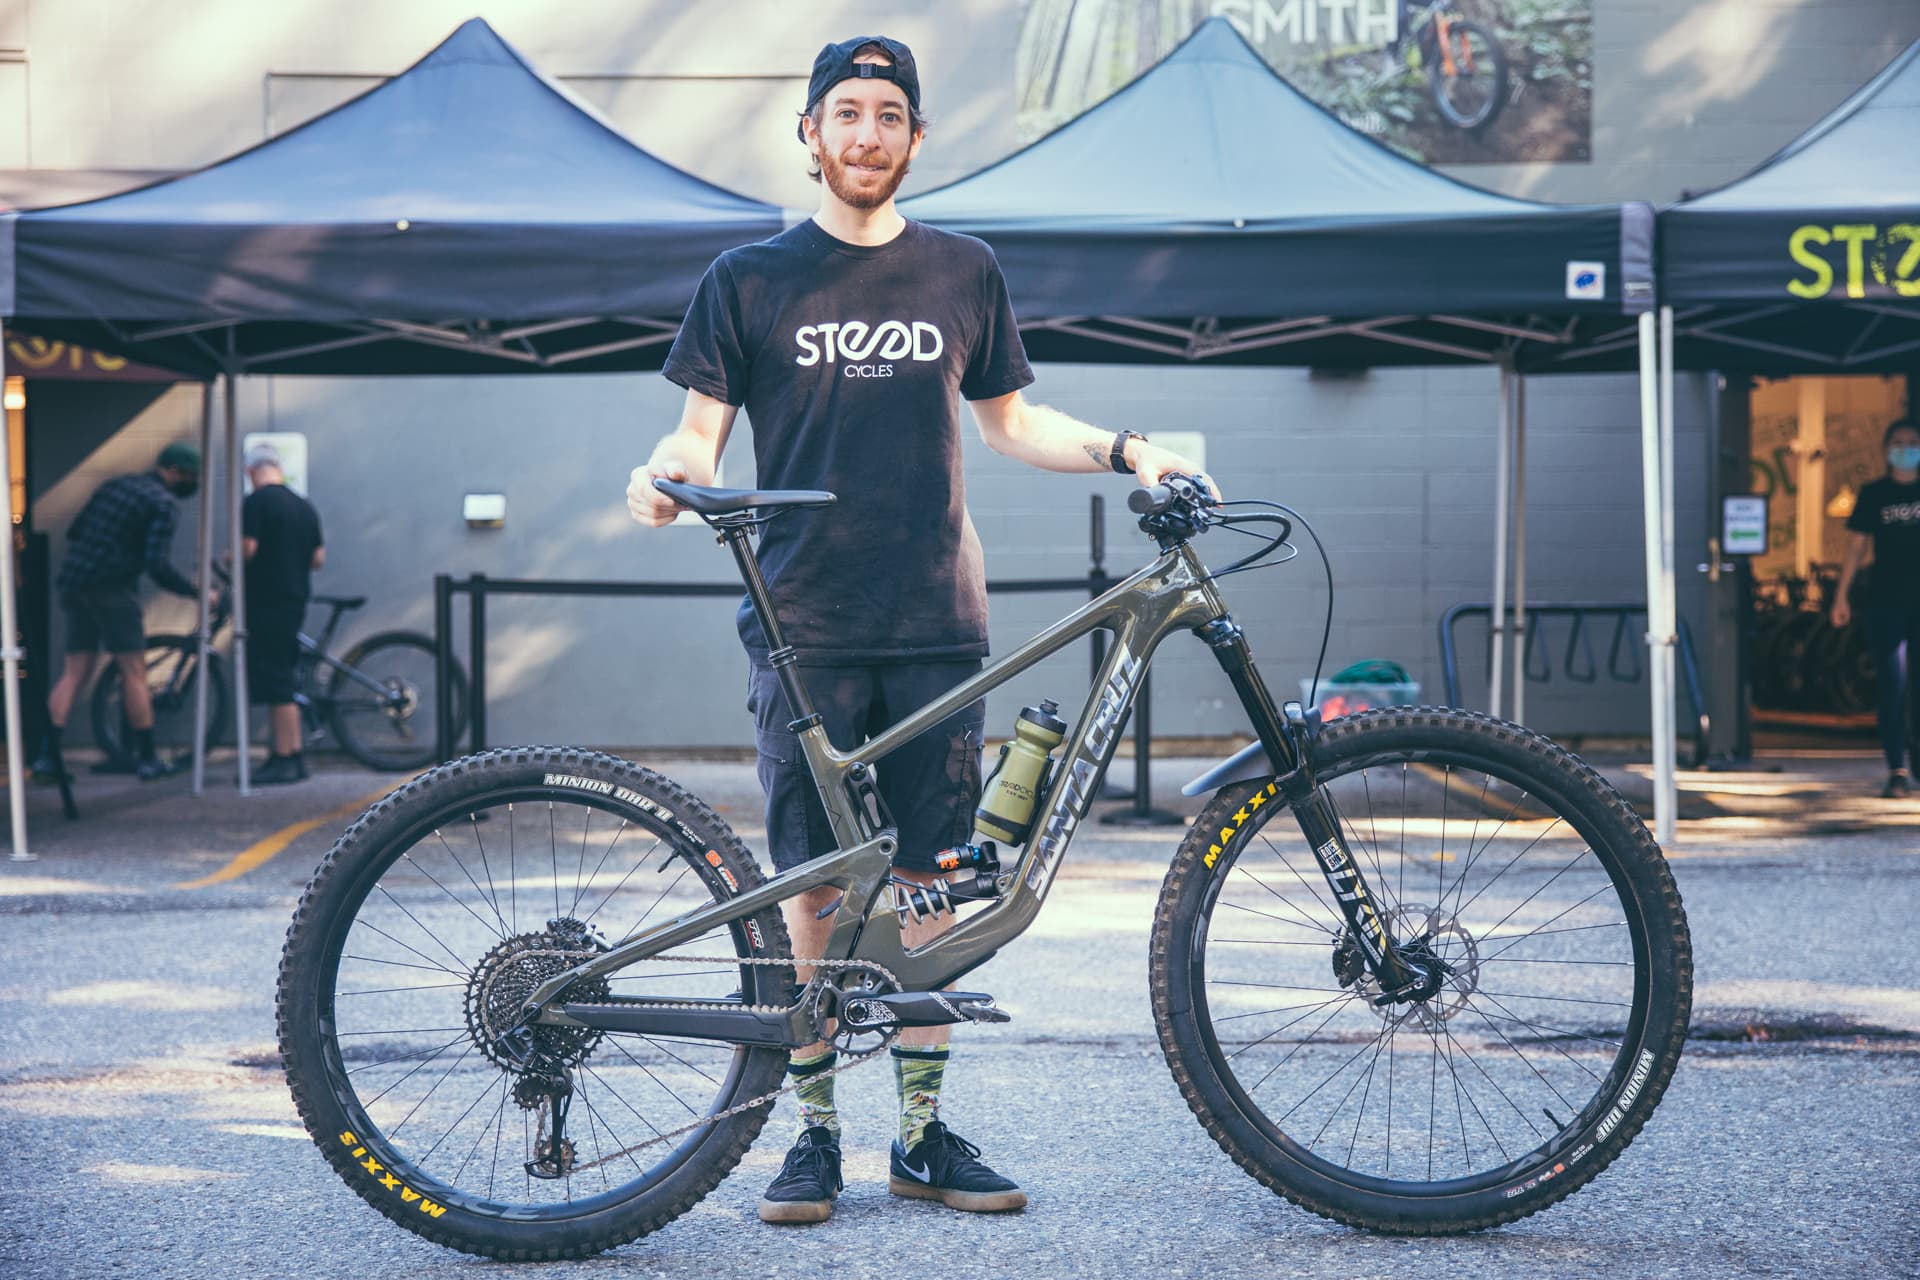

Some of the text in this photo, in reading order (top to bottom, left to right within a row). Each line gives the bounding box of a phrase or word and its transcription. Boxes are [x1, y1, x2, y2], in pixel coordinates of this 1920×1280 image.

[844, 364, 893, 378] CYCLES
[543, 773, 615, 796] MINION
[1203, 782, 1278, 870] MAXXI
[1024, 758, 1098, 901] SANTA
[1596, 1048, 1656, 1143] MINION DHF
[339, 1131, 448, 1218] MAXXIS
